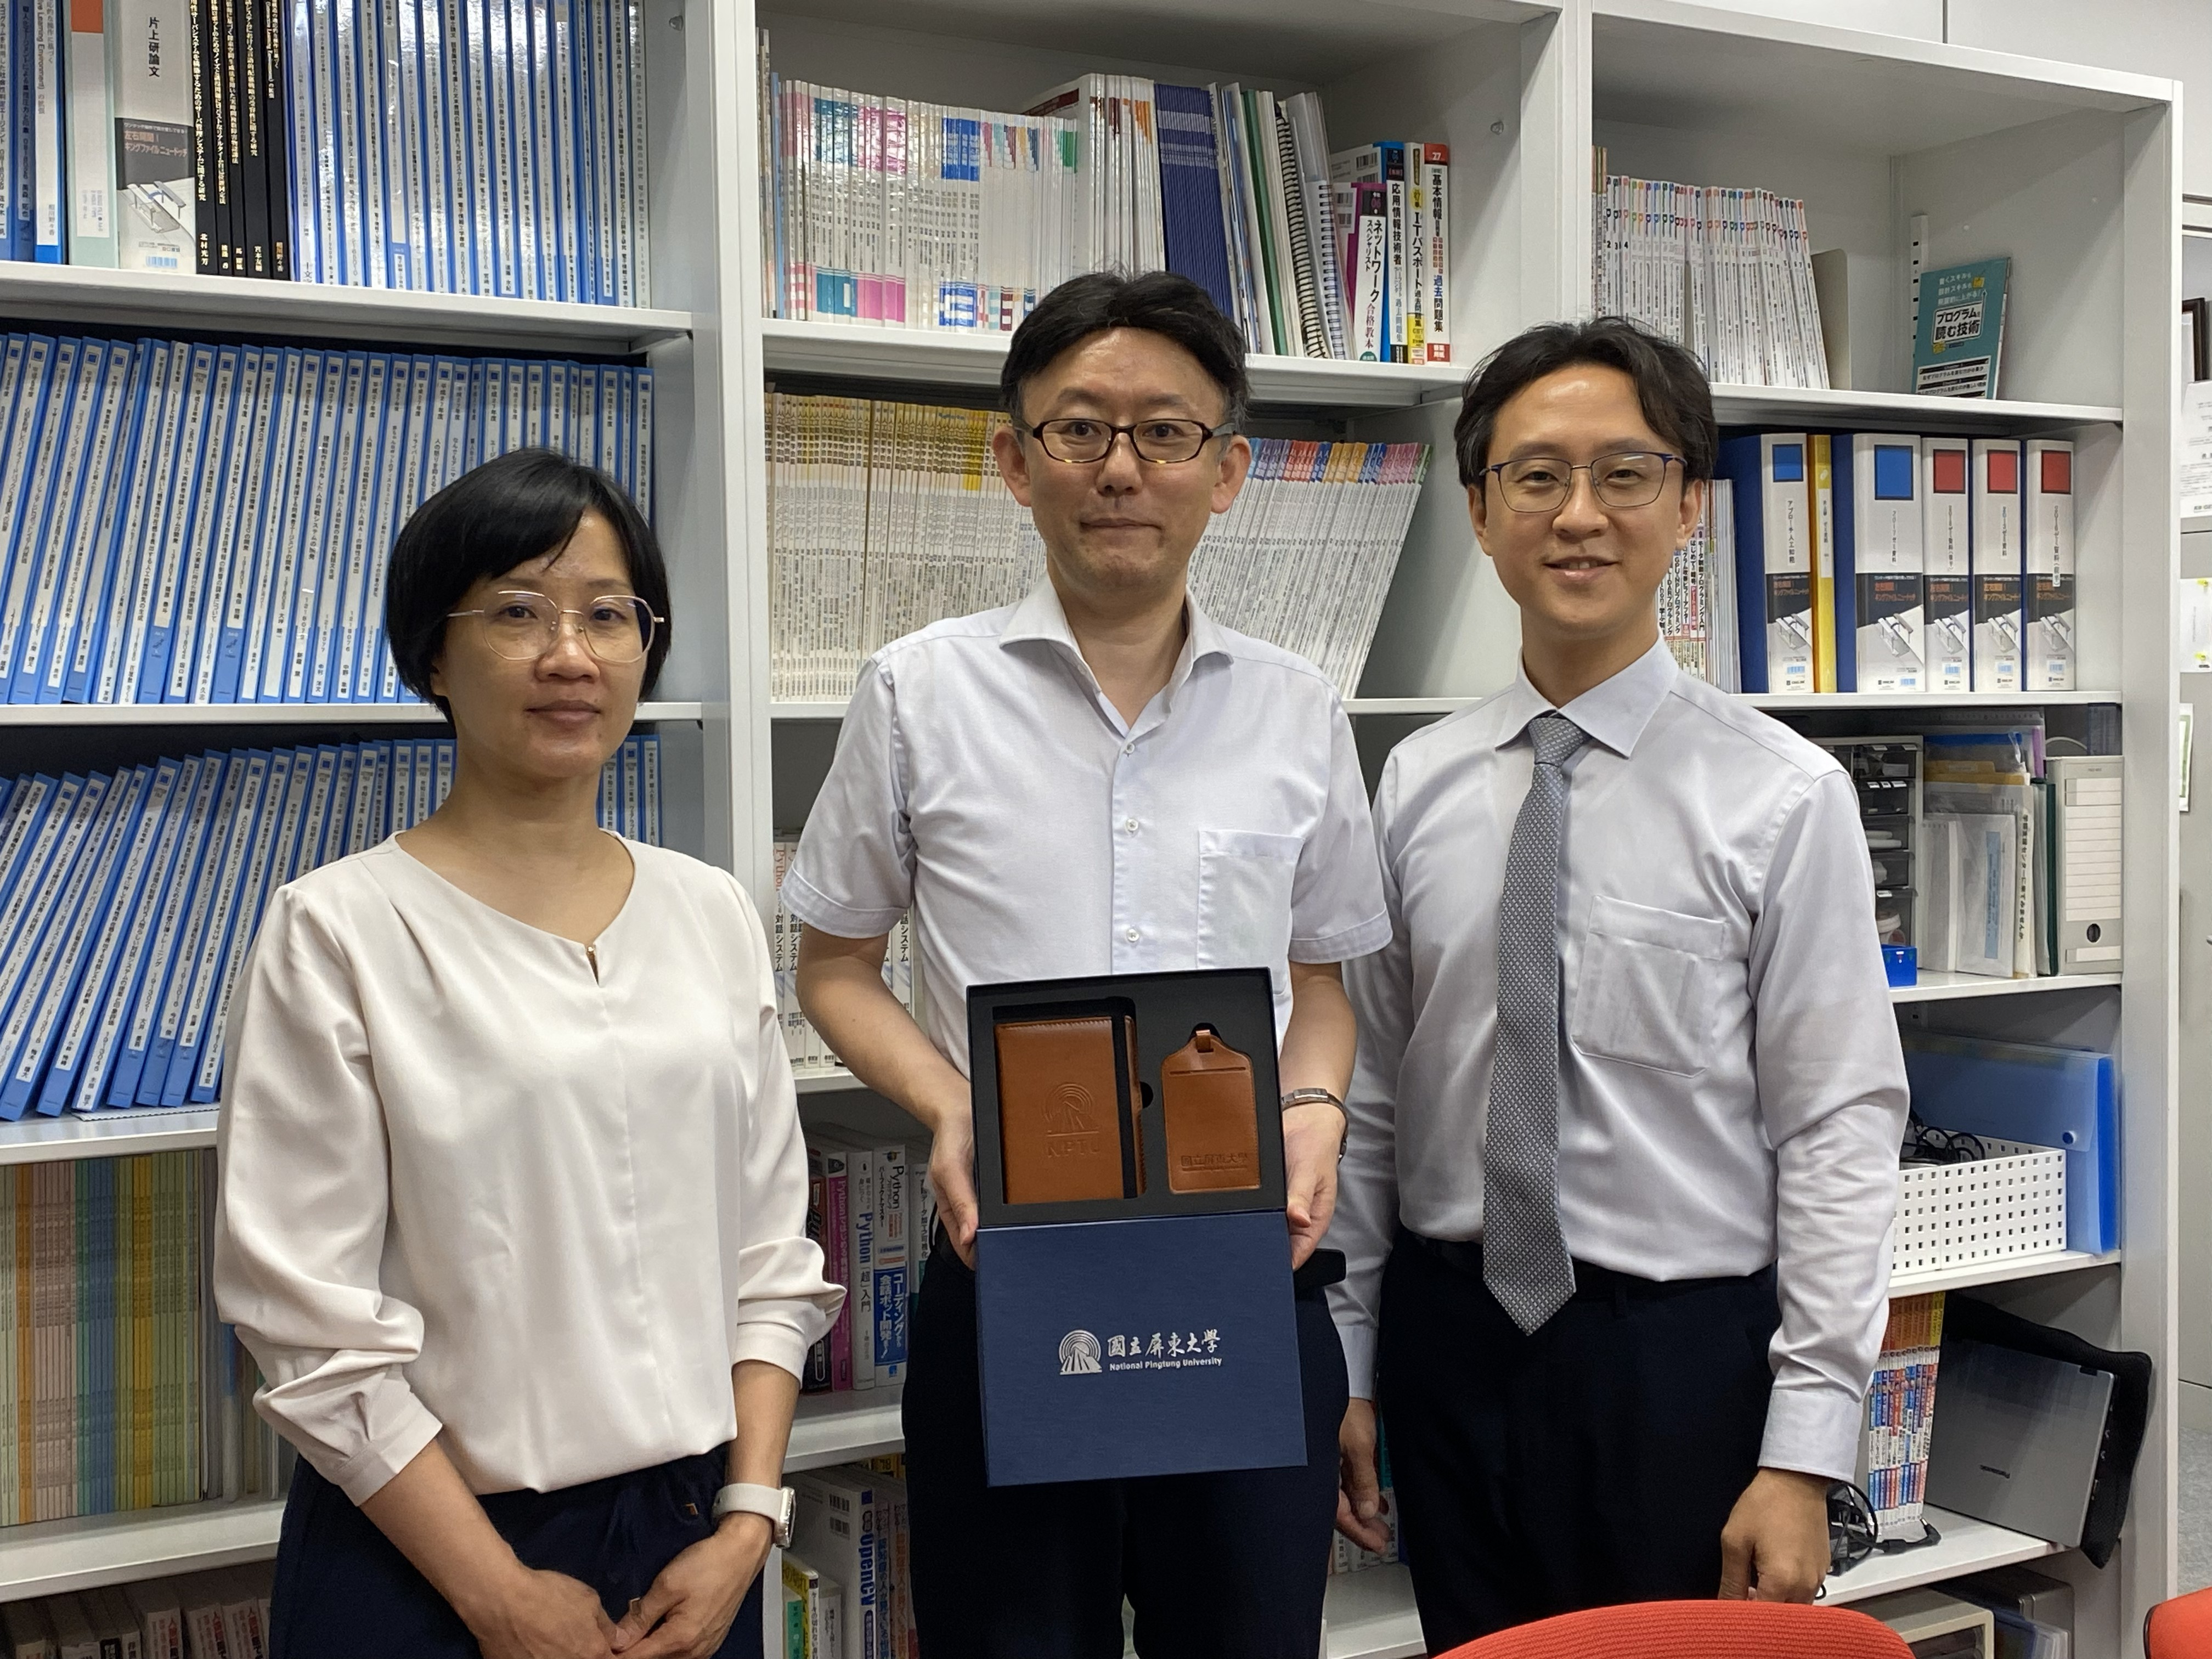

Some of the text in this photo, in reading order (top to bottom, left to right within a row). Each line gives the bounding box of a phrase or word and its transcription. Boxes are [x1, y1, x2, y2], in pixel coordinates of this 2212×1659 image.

[149, 17, 160, 77] 片上研論文
[1432, 152, 1442, 161] 27
[1364, 219, 1374, 272] スペシャリスト
[1392, 183, 1402, 266] 応用情報技術者
[1370, 219, 1383, 303] ネットワーク
[1365, 303, 1375, 349] 合格教本
[1434, 275, 1443, 332] 過去問題集
[1935, 319, 1980, 341] 読む技術
[774, 849, 786, 893] Python
[775, 914, 784, 973] 対話システム
[789, 913, 798, 972] 対話システム
[900, 908, 909, 963] 話システム
[890, 1165, 905, 1209] Python
[856, 1212, 873, 1264] Python
[1107, 1329, 1221, 1359] 國立屏東大學
[1109, 1357, 1223, 1372] National Pingtung University
